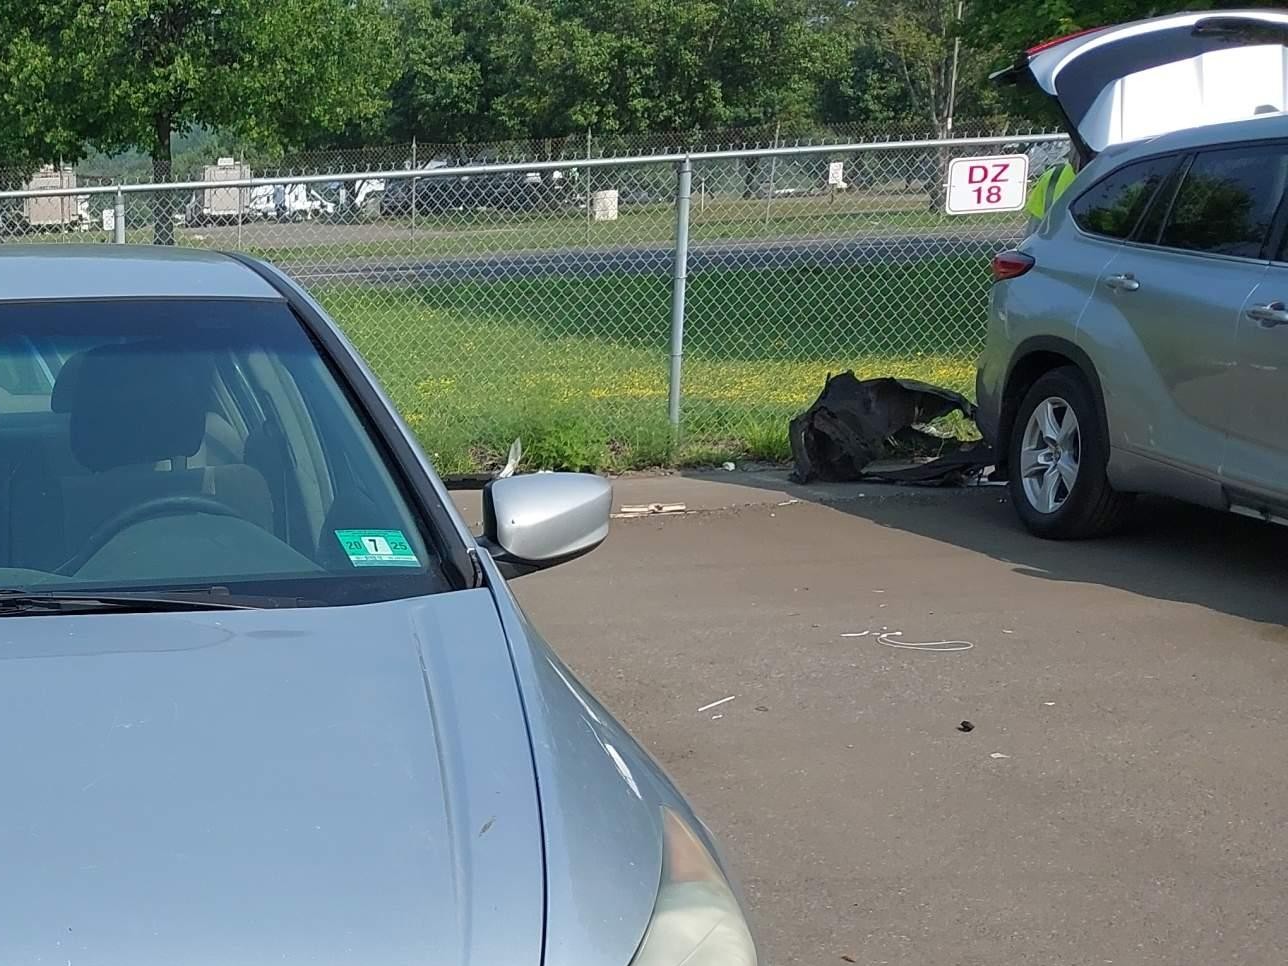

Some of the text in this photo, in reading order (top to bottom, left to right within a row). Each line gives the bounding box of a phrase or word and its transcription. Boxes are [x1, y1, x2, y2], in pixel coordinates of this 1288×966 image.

[968, 163, 1010, 184] DZ
[972, 185, 1002, 204] 18
[345, 538, 408, 553] 20 7 25
